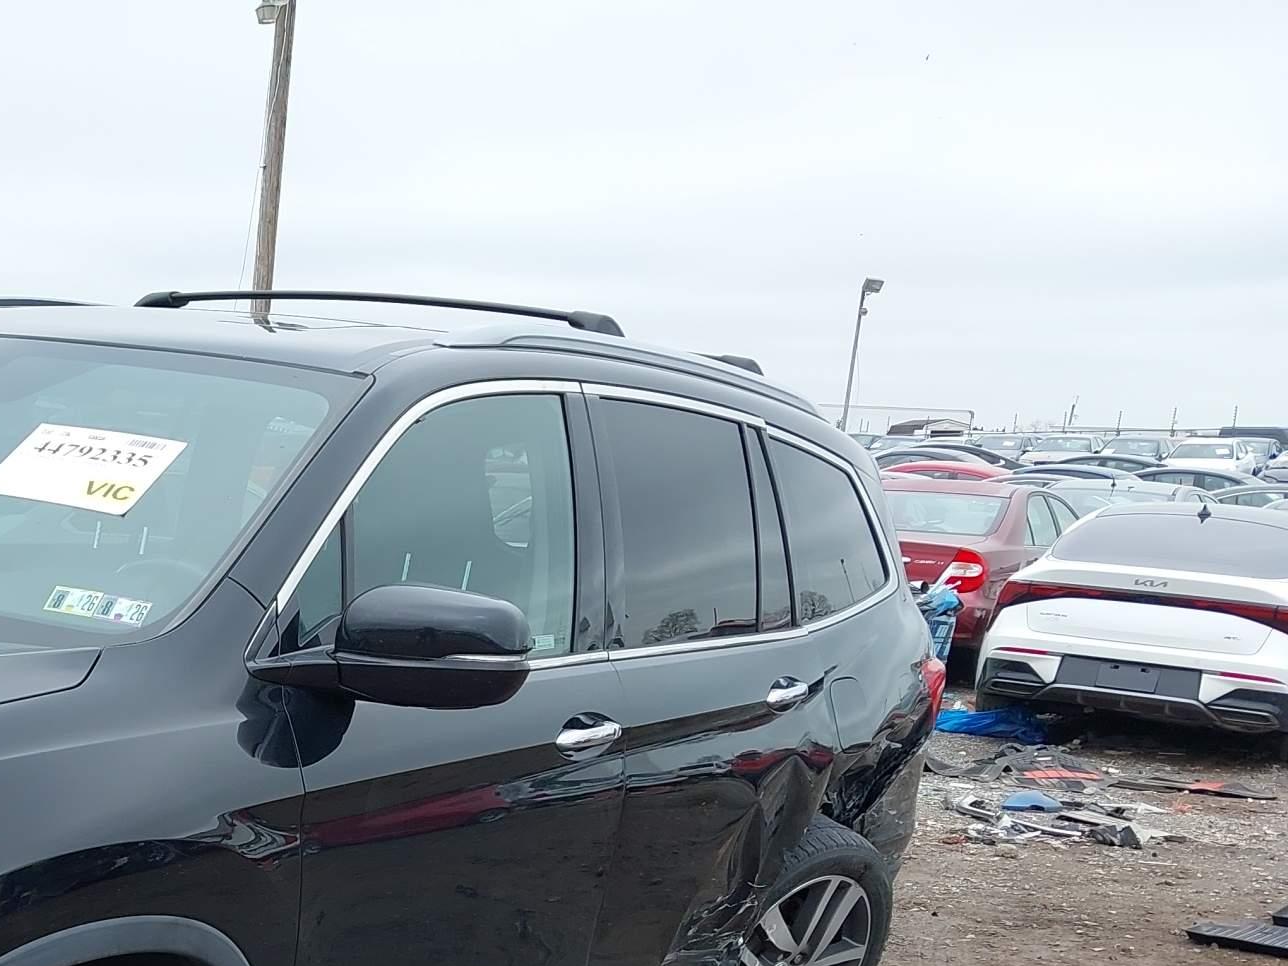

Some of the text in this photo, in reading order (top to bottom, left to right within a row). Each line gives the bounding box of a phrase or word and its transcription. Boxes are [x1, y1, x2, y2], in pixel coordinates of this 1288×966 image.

[34, 440, 153, 468] 44792335
[86, 480, 136, 501] VIC
[1134, 579, 1169, 588] KIA
